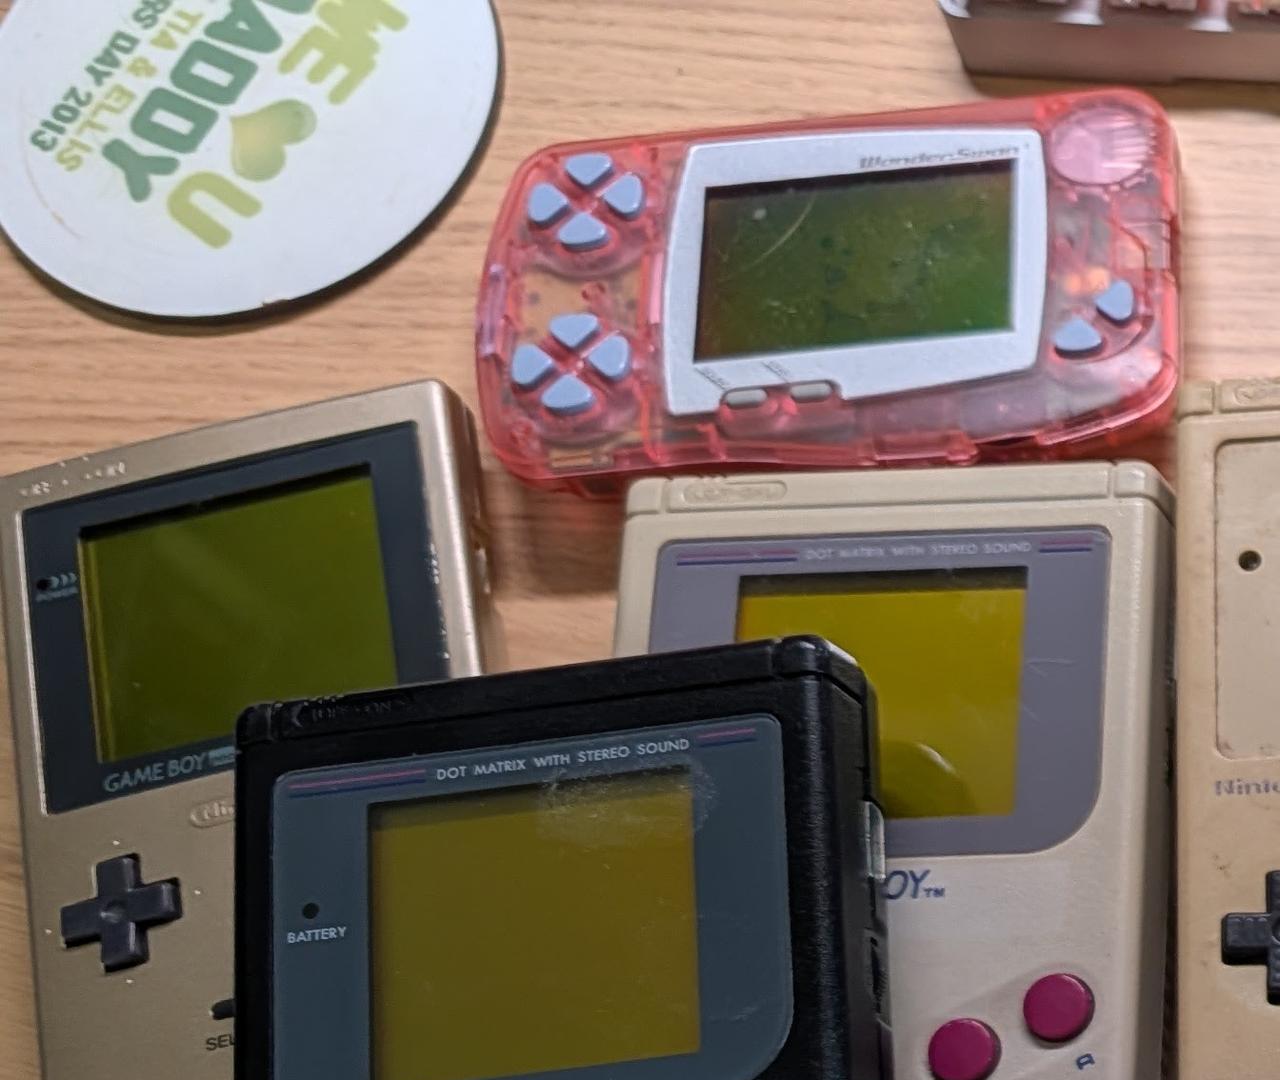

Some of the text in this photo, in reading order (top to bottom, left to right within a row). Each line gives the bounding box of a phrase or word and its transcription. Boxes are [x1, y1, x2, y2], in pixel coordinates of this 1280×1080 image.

[150, 9, 203, 50] TIA
[30, 31, 140, 151] DAY 2013
[103, 0, 316, 202] ADDY
[167, 171, 262, 249] U
[436, 737, 690, 781] DOT MATRIX WITH STEREO SOUND
[883, 869, 930, 901] OY
[286, 925, 348, 945] BATTERY
